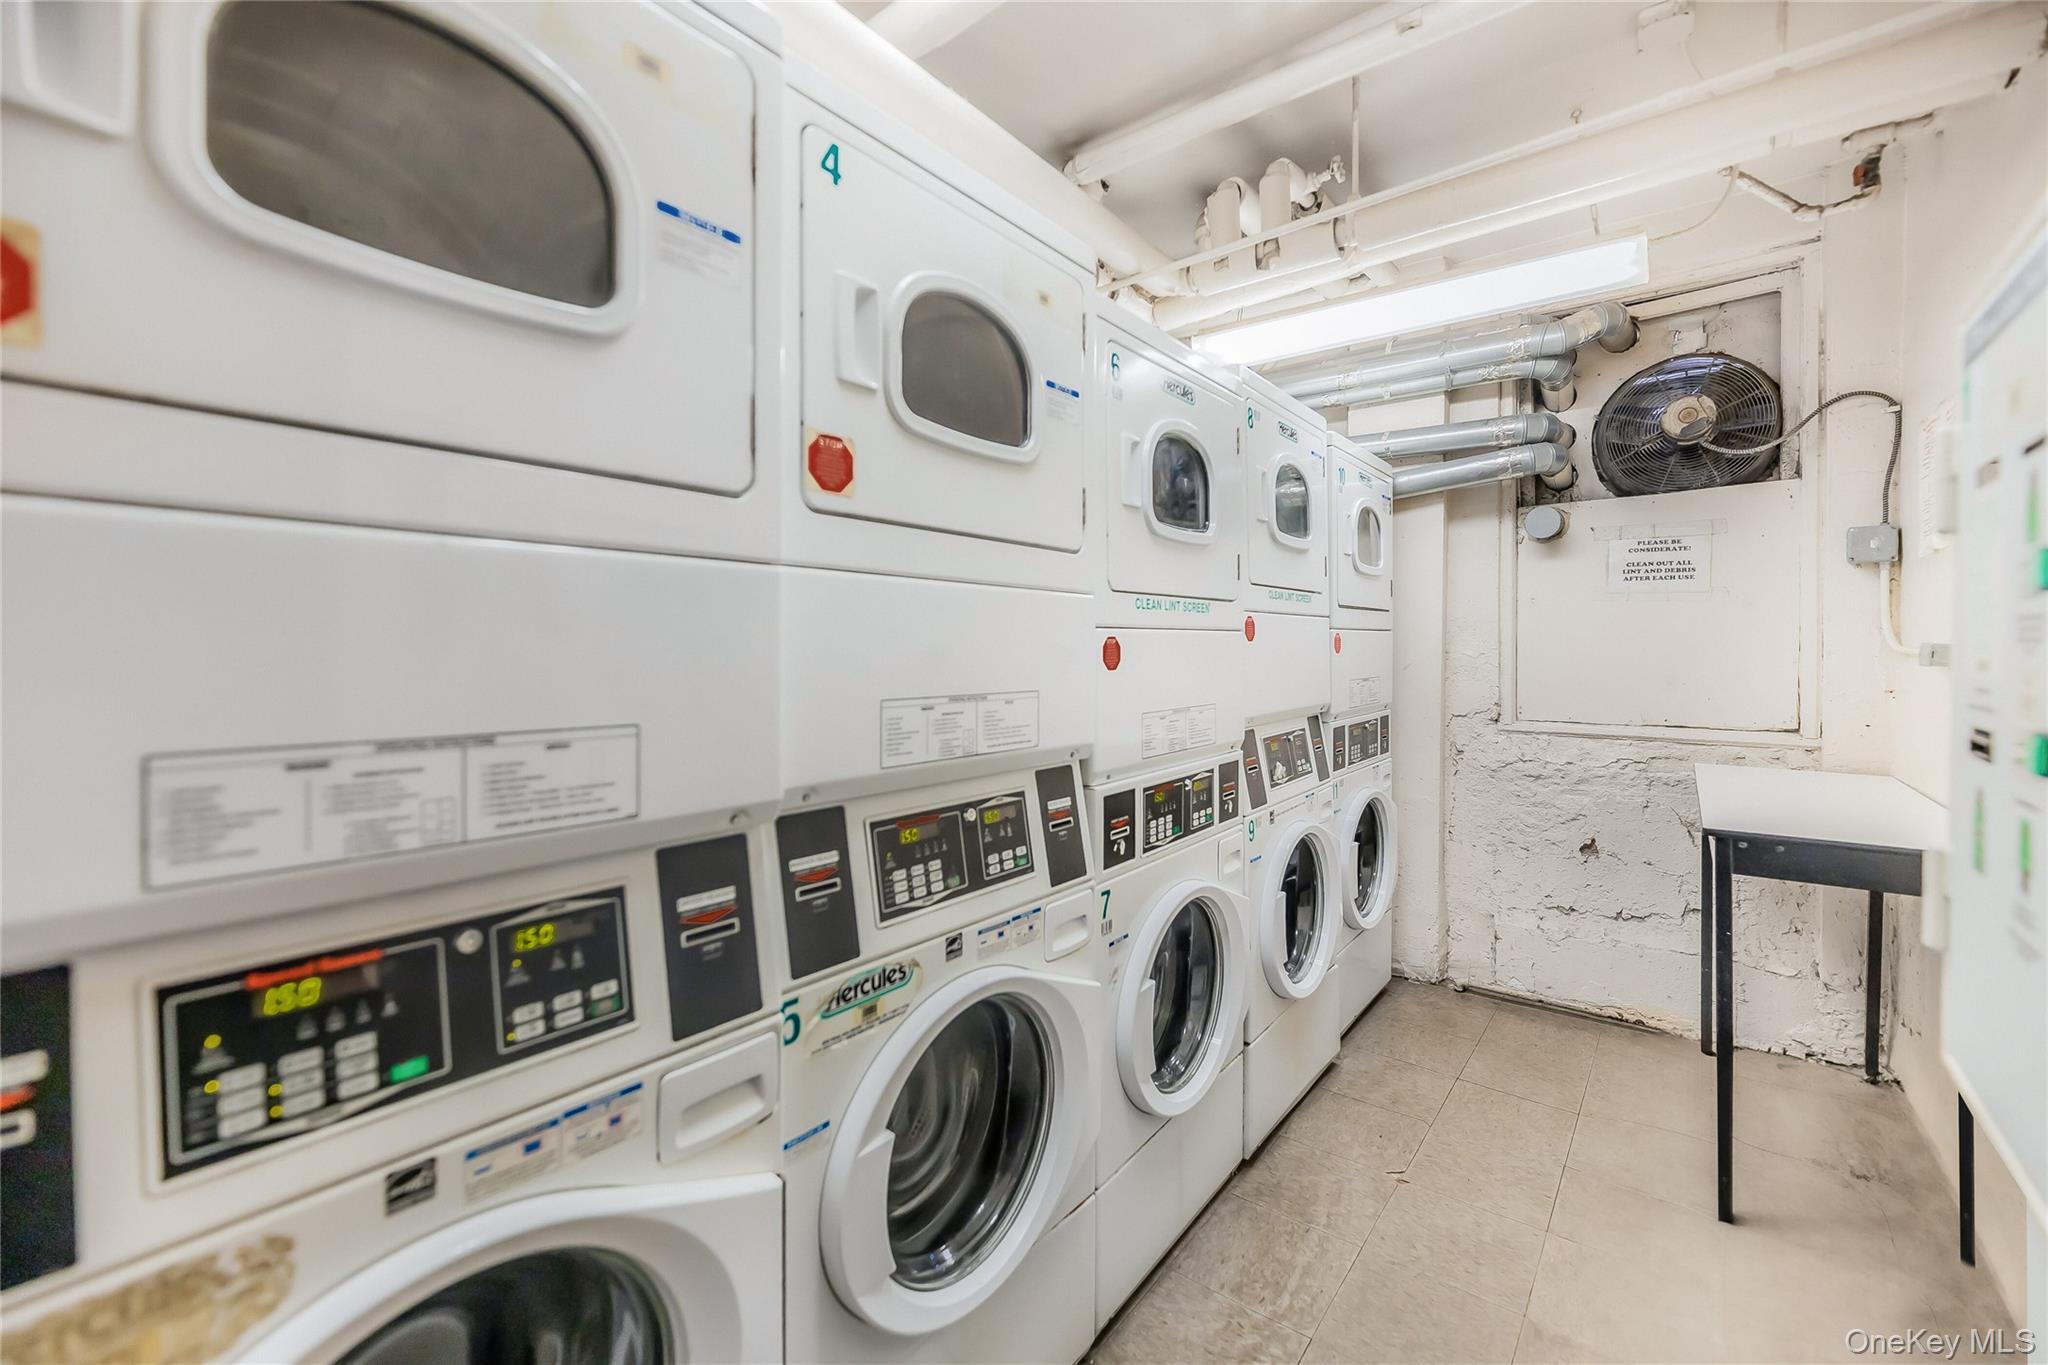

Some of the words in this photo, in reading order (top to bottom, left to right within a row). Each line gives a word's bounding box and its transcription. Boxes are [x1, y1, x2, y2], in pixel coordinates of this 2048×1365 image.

[821, 143, 841, 185] 4
[1111, 352, 1120, 381] 6
[1247, 407, 1254, 429] 8
[1628, 545, 1692, 553] CONSIDERATE!
[1135, 597, 1162, 610] CLEAN
[1164, 600, 1181, 611] LINT
[1183, 601, 1211, 614] SCREEN
[1248, 819, 1255, 842] 9
[1100, 888, 1111, 919] 7
[780, 996, 801, 1046] 5
